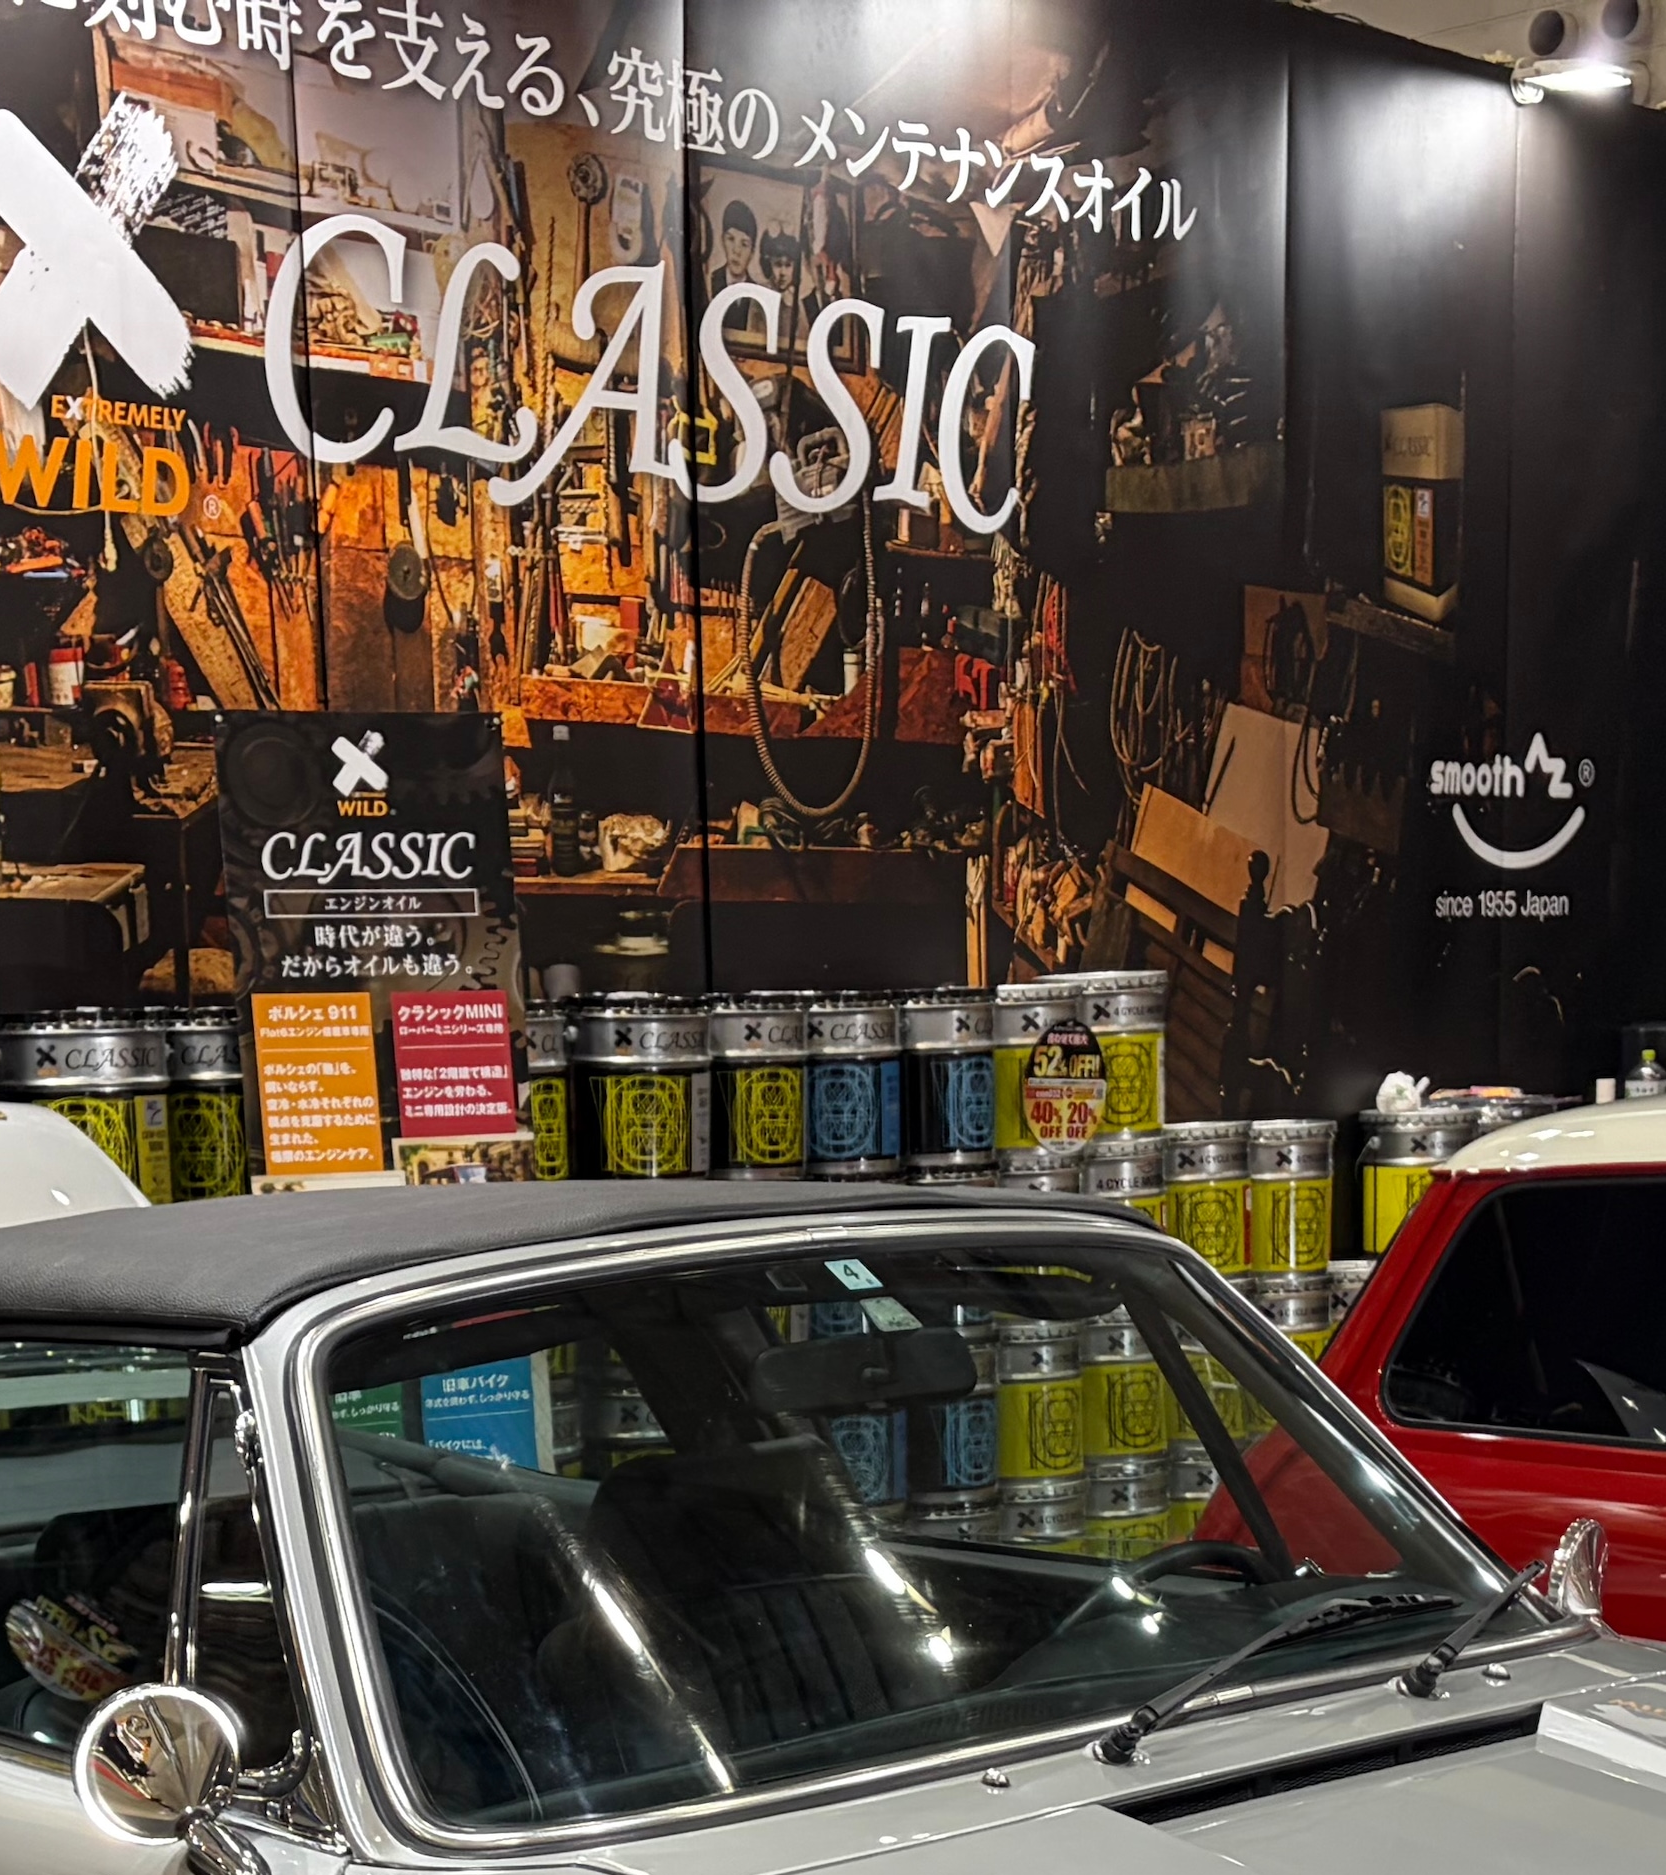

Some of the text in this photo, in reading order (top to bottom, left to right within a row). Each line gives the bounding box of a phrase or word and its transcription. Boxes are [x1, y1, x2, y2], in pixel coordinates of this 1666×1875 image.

[265, 213, 1036, 535] CLASSIC
[49, 394, 188, 433] EXTREMELY
[336, 799, 389, 817] WILD
[261, 831, 476, 884] CLASSIC
[324, 895, 422, 911] エンジンオイル
[1435, 889, 1569, 923] since 1955 Japan
[313, 924, 436, 948] 時代が違う。
[281, 953, 474, 978] だからオイルも違う。
[267, 1003, 358, 1023] ポルシェ 911
[397, 1003, 503, 1023] クラシックMINI
[64, 1045, 156, 1072] CLASSIC
[842, 1263, 860, 1280] 4
